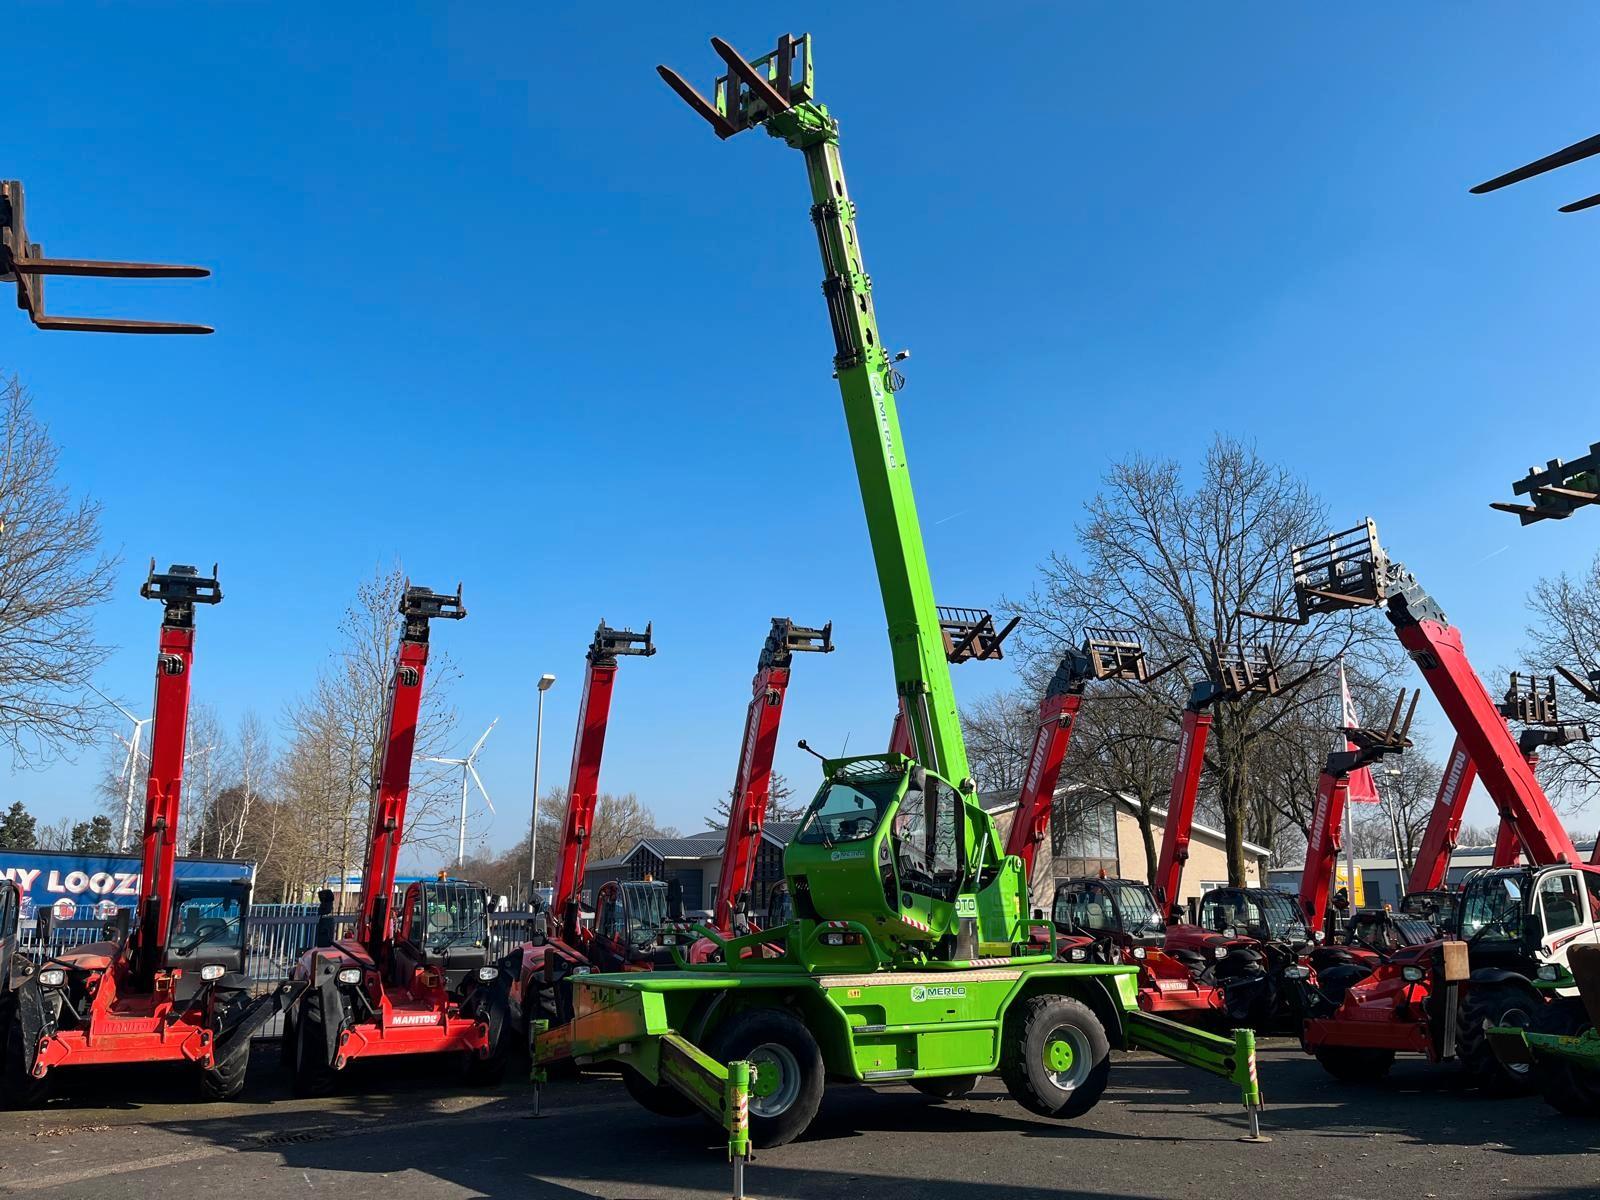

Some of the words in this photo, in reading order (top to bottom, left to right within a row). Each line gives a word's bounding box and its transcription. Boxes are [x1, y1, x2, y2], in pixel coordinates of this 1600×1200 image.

[879, 401, 896, 468] MERLO
[742, 704, 759, 779] MANITOU
[1026, 726, 1049, 793] MANITOU
[1177, 731, 1189, 773] MANITOU
[1441, 750, 1466, 806] MANITOU
[1311, 793, 1328, 852] MANITOU
[47, 870, 142, 895] LOOZ
[927, 987, 966, 996] MERLO
